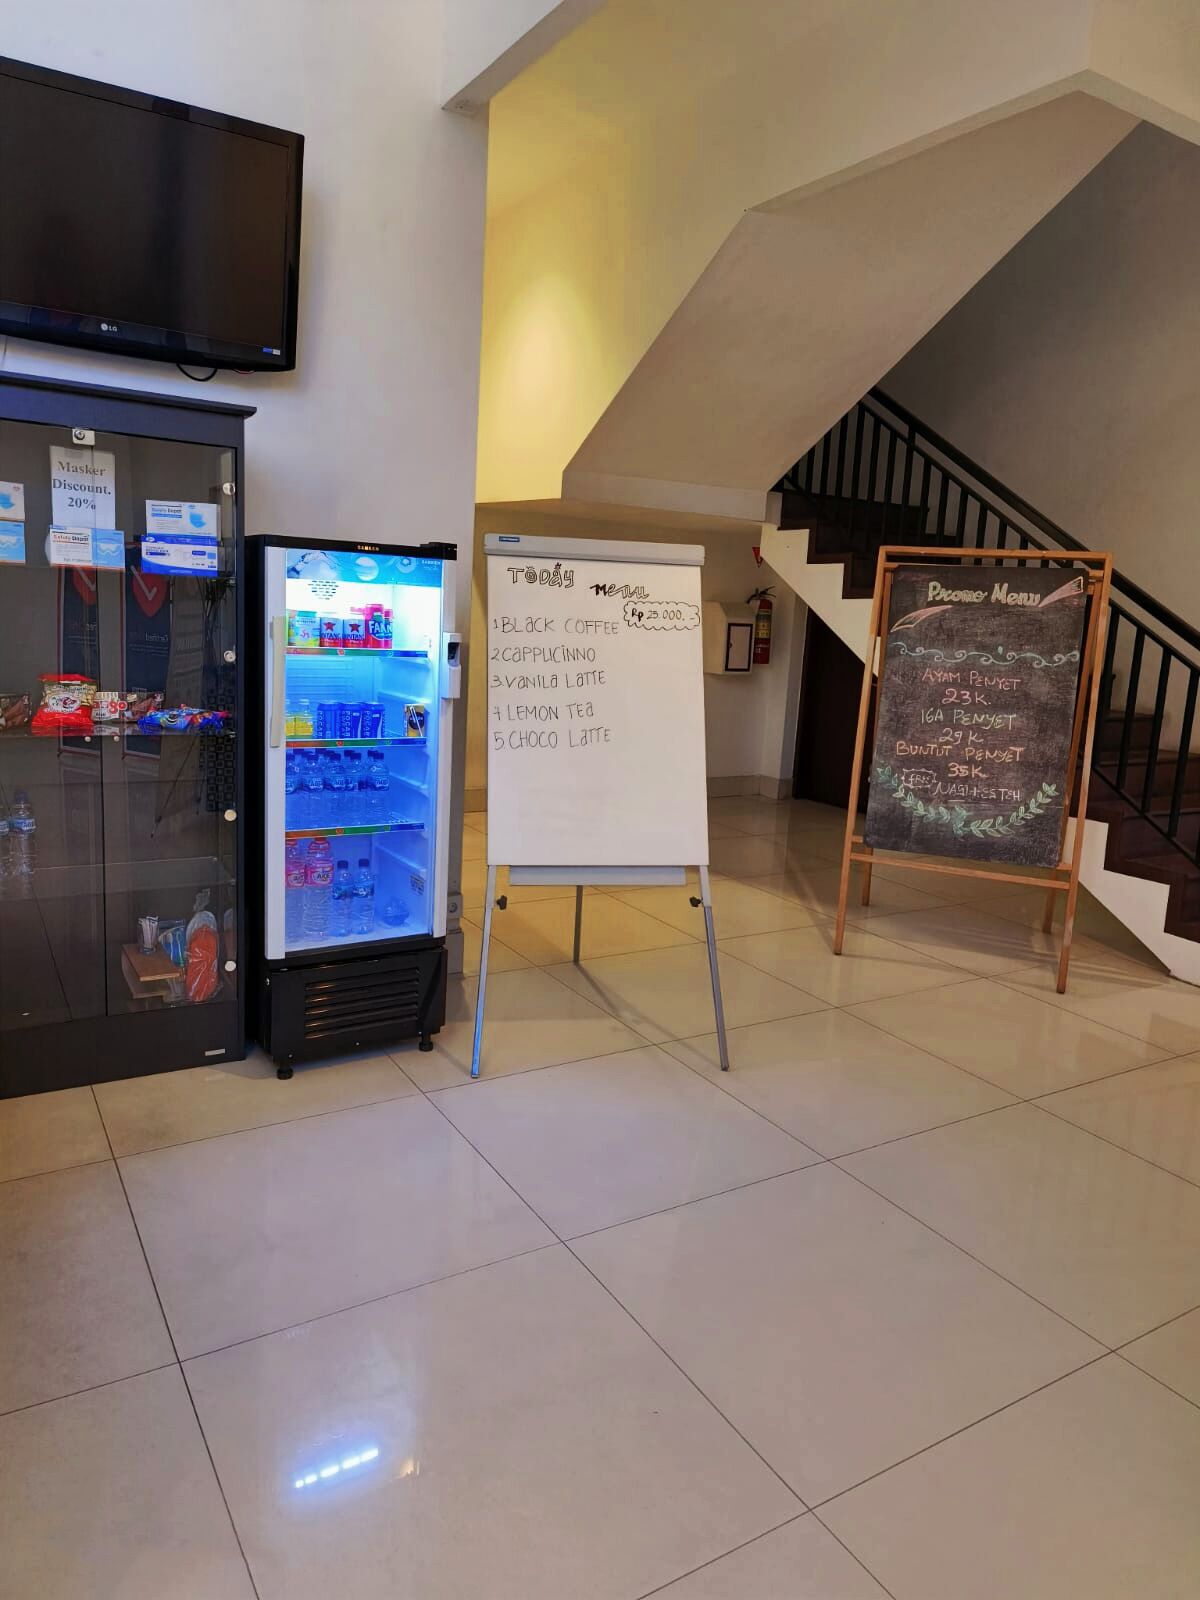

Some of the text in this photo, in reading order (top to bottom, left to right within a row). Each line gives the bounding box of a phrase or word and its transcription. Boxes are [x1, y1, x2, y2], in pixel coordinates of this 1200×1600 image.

[57, 460, 106, 477] Masker
[52, 478, 112, 495] Discount.
[67, 496, 97, 511] 20%
[927, 580, 1041, 607] Promo Menu
[631, 607, 644, 623] Rp
[564, 617, 620, 635] COFFEE
[921, 668, 1021, 691] AYAM PENYET
[507, 703, 559, 722] LEMON
[953, 709, 1017, 731] PENYET
[508, 730, 558, 750] CHOCO
[896, 740, 1025, 763] BUNTUT PENYET
